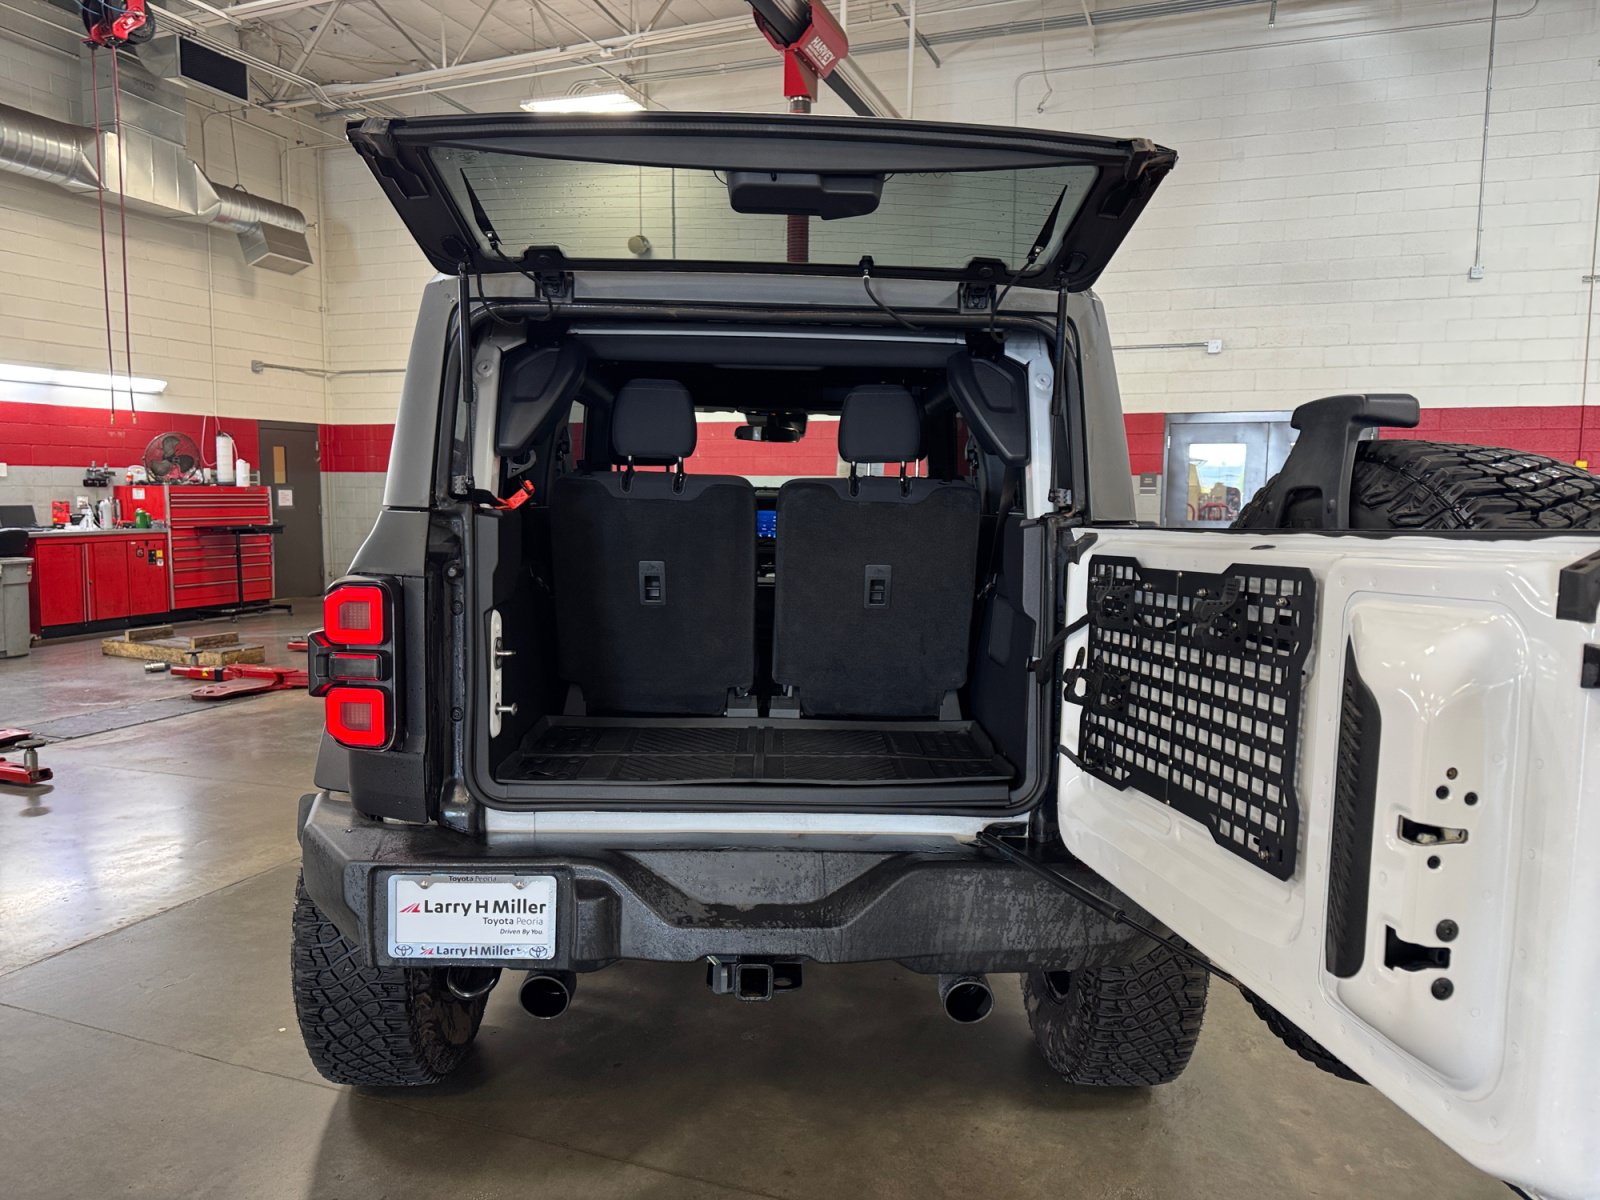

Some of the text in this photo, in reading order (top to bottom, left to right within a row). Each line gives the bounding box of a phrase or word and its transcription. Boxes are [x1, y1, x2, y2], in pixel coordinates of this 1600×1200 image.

[424, 898, 547, 916] Larry H Miller
[483, 917, 544, 926] Toyota Peoria
[521, 928, 530, 936] By
[436, 945, 515, 957] Larry H Miller
